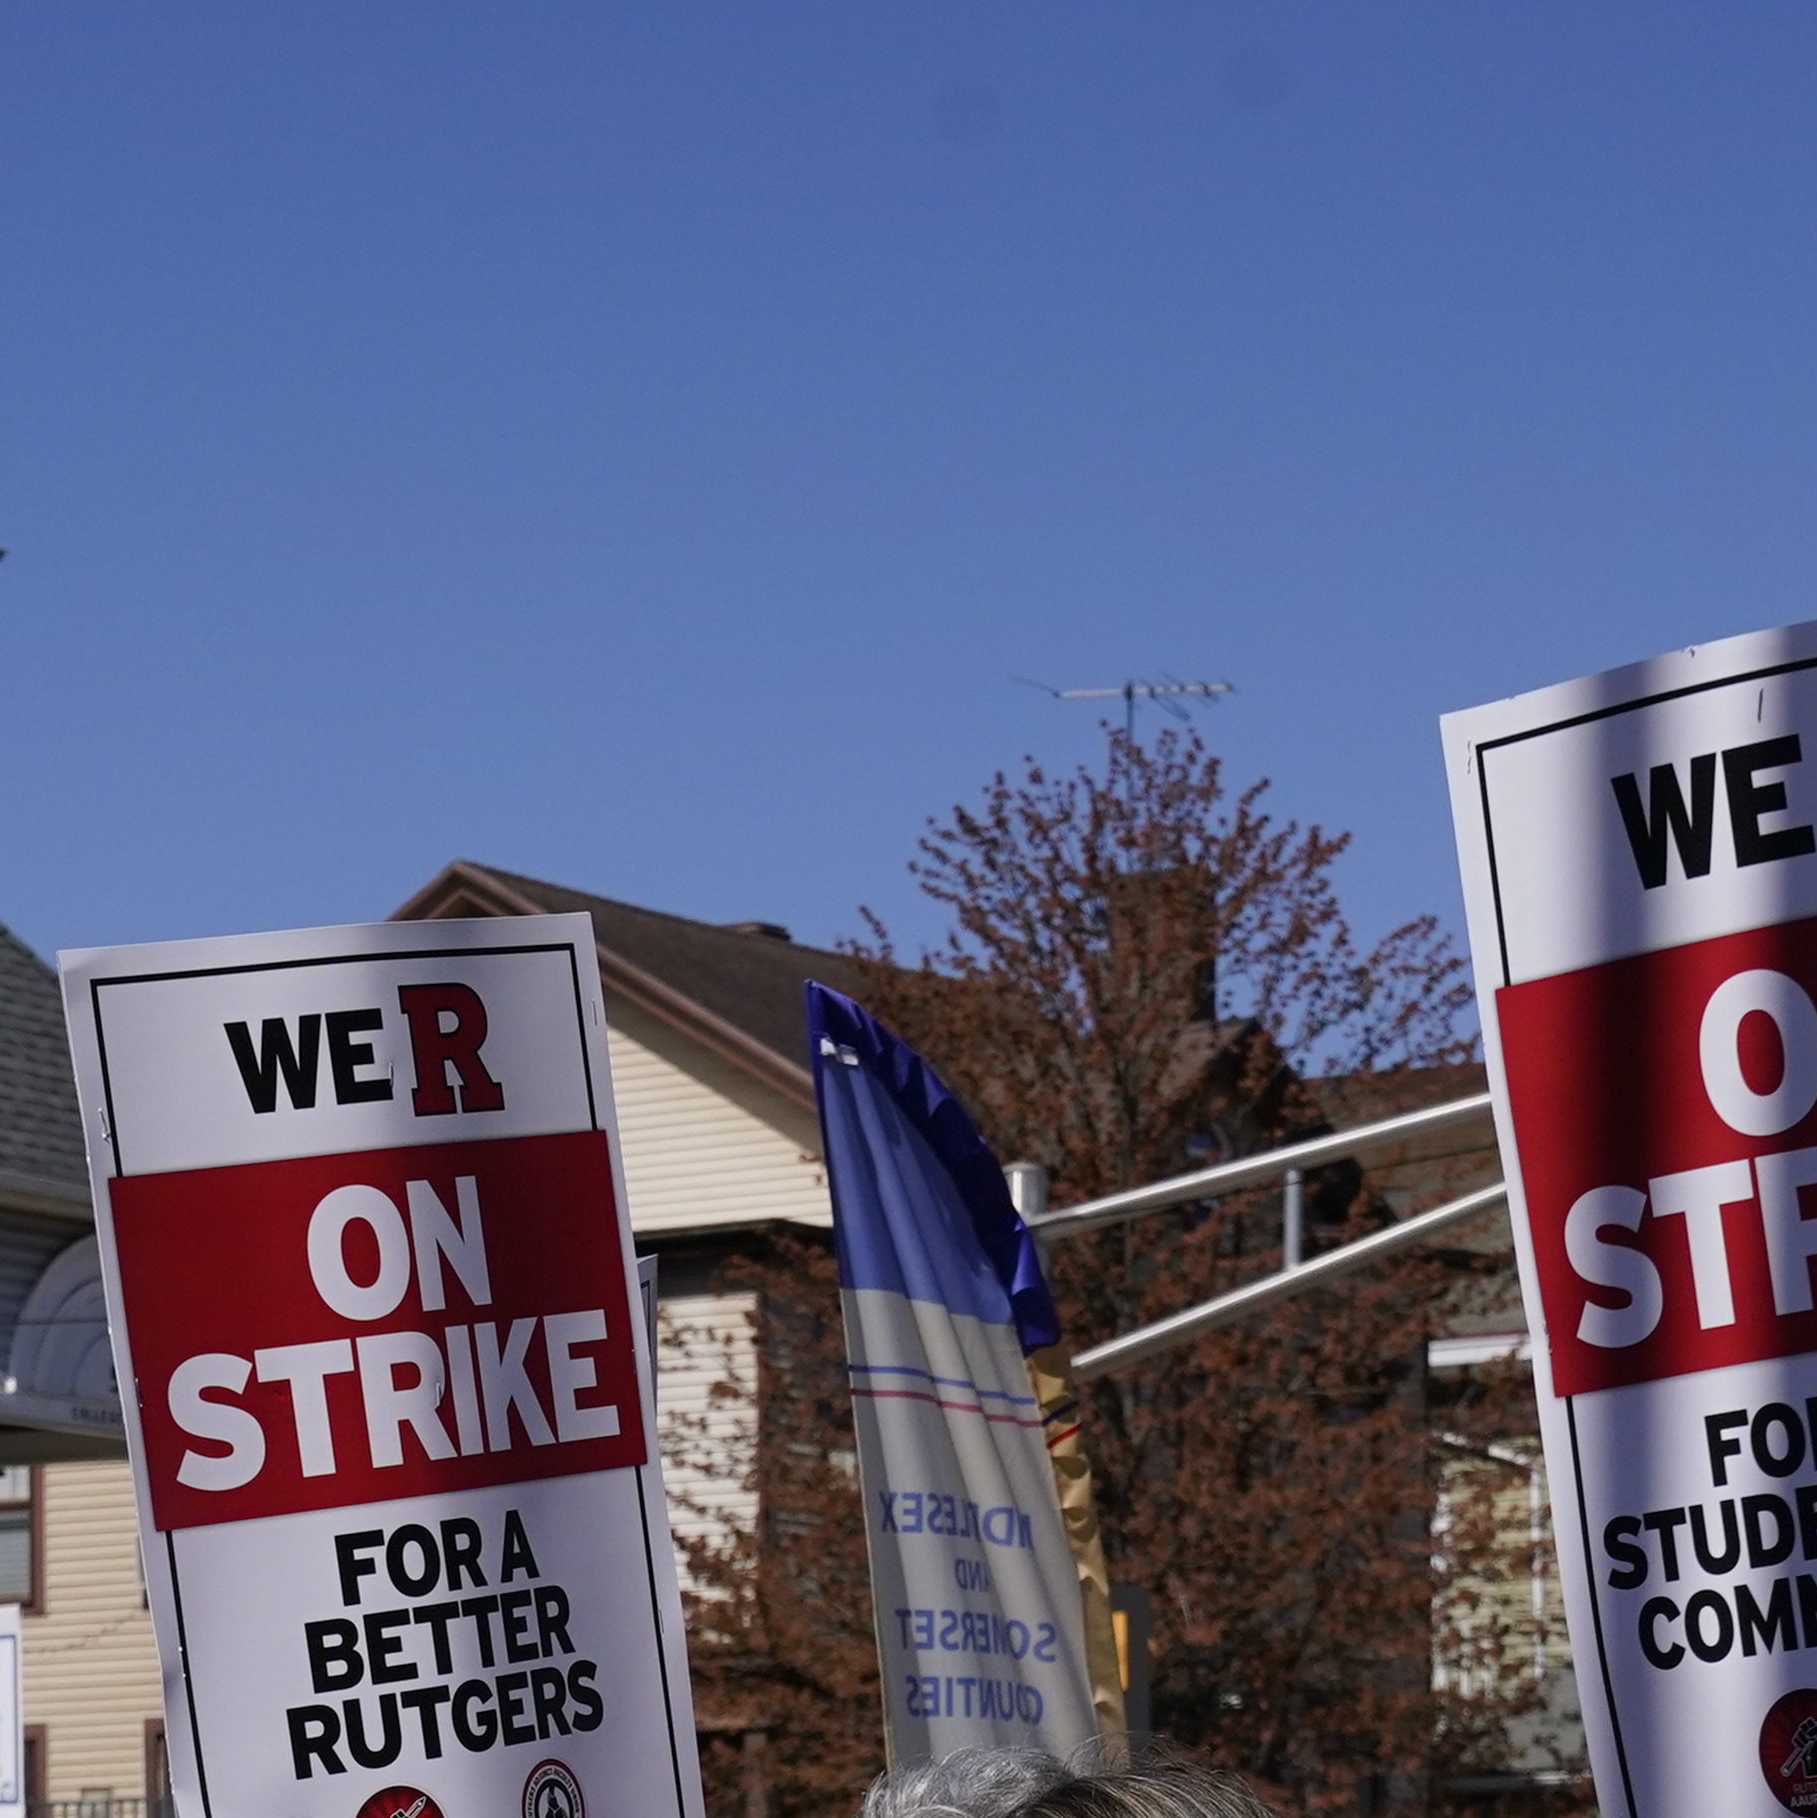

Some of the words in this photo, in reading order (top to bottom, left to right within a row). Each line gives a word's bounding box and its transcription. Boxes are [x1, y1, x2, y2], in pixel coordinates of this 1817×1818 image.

[1612, 734, 1815, 891] WE
[224, 1008, 393, 1114] WE
[399, 982, 505, 1118] R
[307, 1175, 492, 1321] ON
[167, 1309, 620, 1492] STRIKE
[334, 1517, 488, 1606] FOR
[500, 1509, 540, 1584] A
[305, 1584, 577, 1695] BETTER
[286, 1661, 604, 1780] RUTGERS
